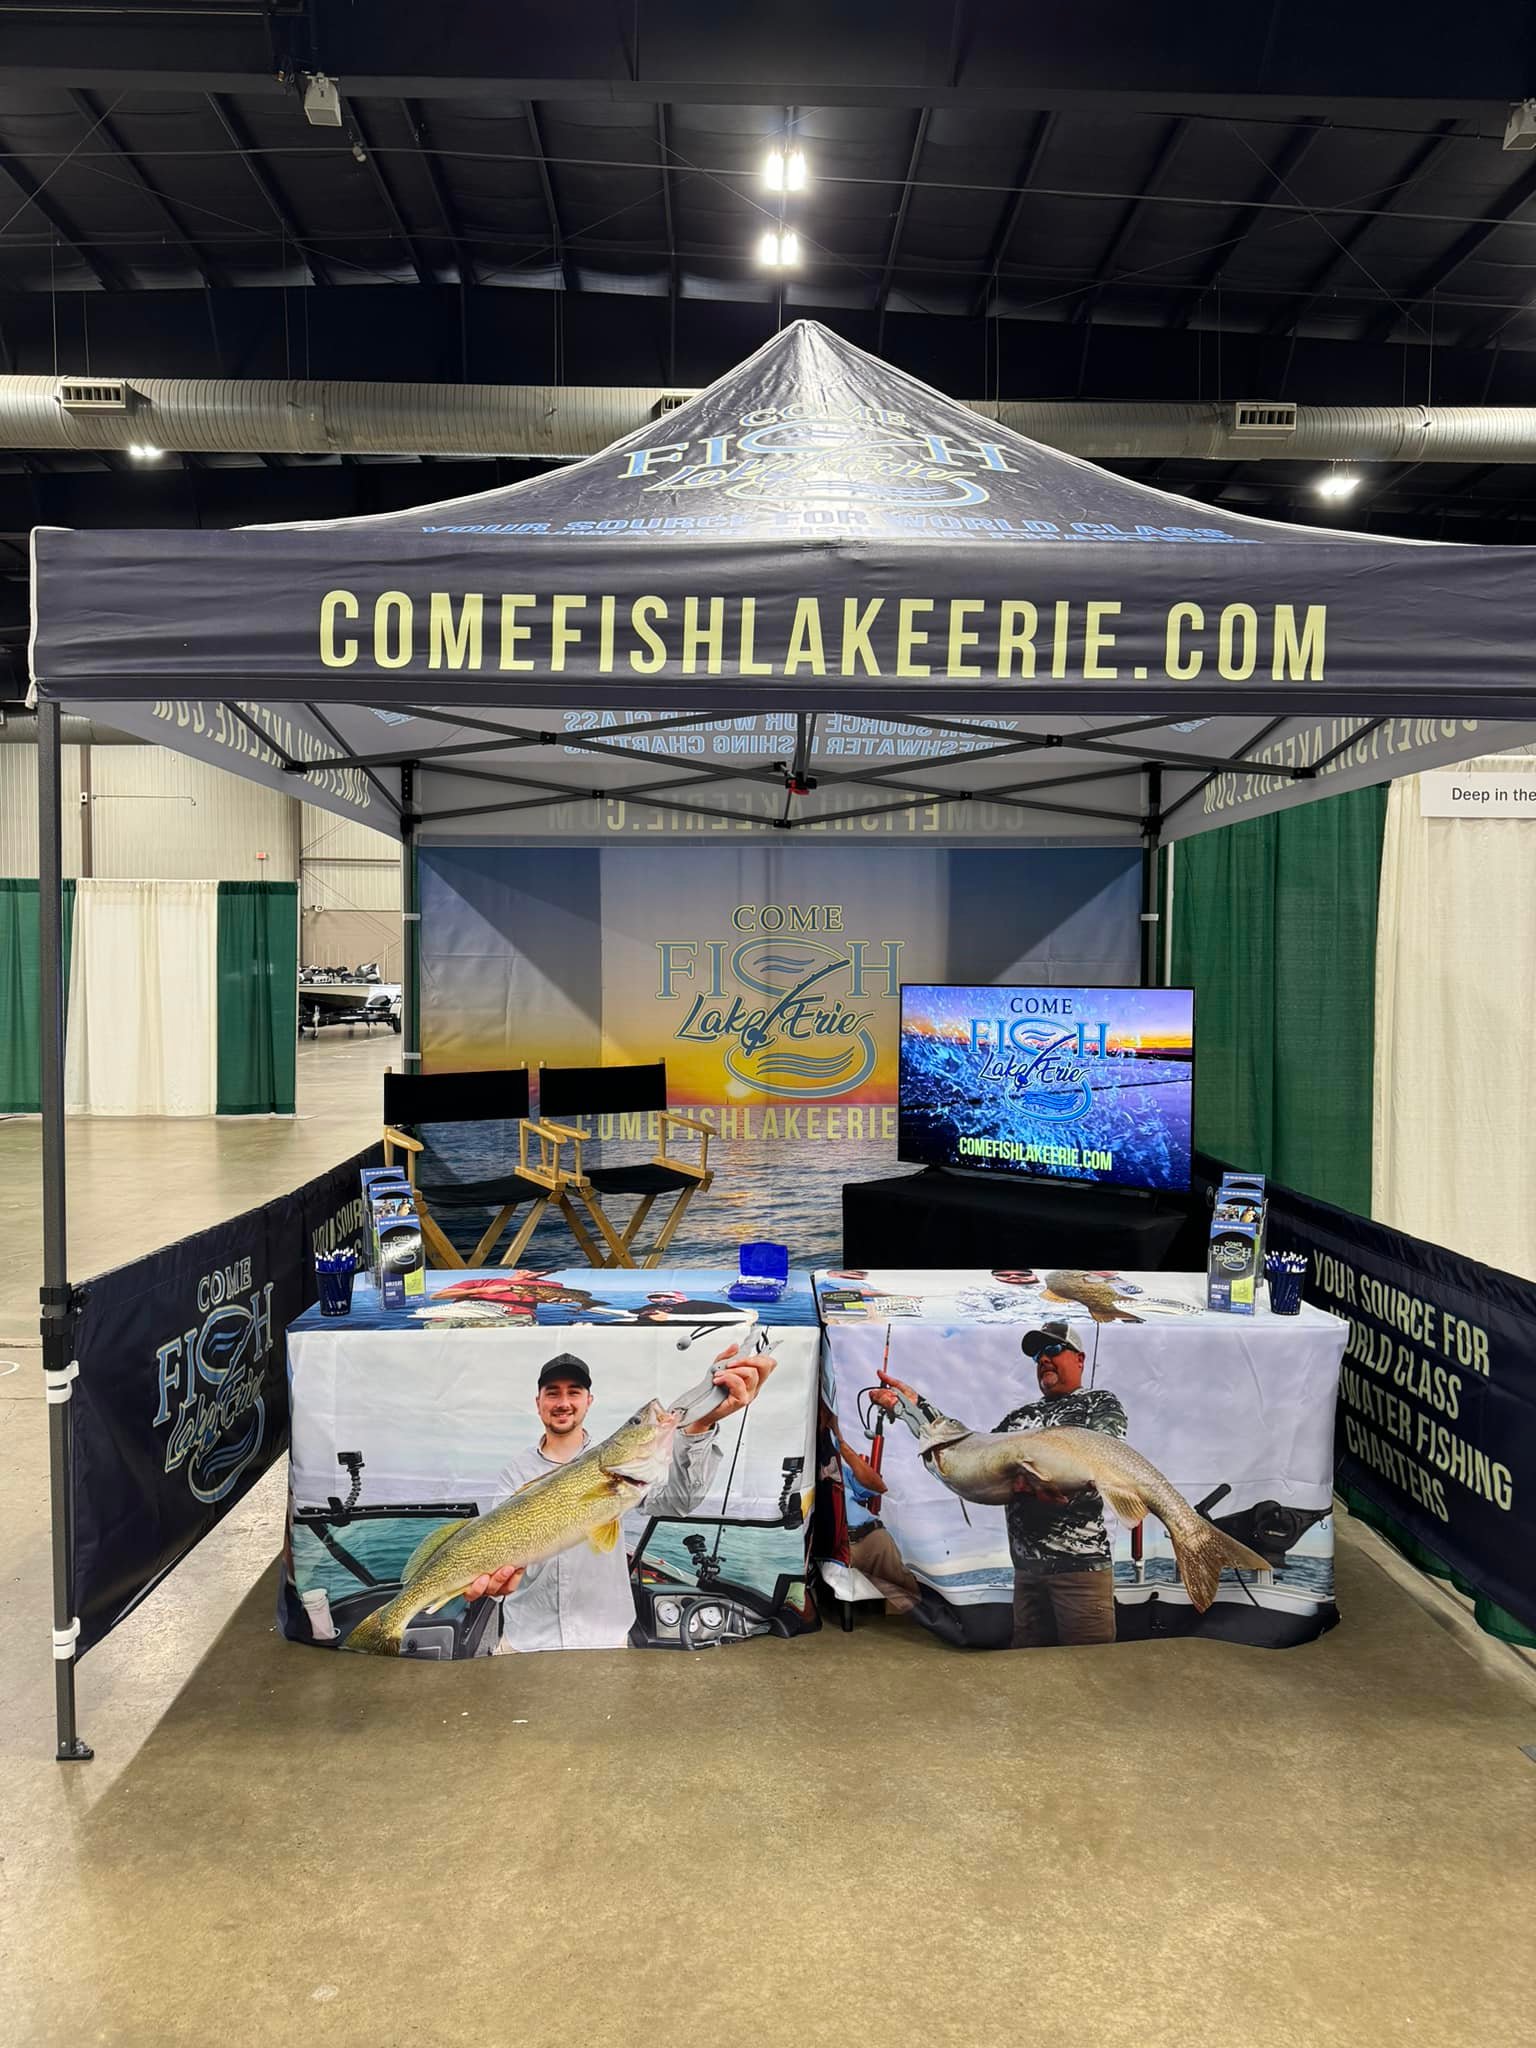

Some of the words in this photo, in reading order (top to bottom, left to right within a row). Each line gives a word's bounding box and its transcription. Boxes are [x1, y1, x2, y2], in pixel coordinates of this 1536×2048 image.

[739, 403, 909, 428] COME
[421, 521, 552, 535] YOUR
[564, 512, 753, 531] SOURCE
[773, 509, 868, 528] FOR
[890, 512, 1061, 535] WORLD
[1068, 521, 1236, 539] CLASS
[319, 589, 1327, 682] COMEFISHLAKEERIE.COM
[1452, 787, 1490, 804] Deep
[1495, 788, 1508, 801] in
[1513, 788, 1536, 801] the
[732, 904, 844, 932] COME
[674, 994, 775, 1054] Lake
[780, 995, 875, 1039] Erie
[1010, 997, 1074, 1015] COME
[977, 1052, 1033, 1090] Lake
[1036, 1056, 1090, 1084] Erie
[959, 1136, 1113, 1171] COMEFISHLAKEERIE.COM
[197, 1256, 253, 1312] COME
[1313, 1249, 1357, 1308] YOUR
[1360, 1274, 1437, 1349] SOURCE
[1443, 1311, 1490, 1377] FOR
[1330, 1305, 1393, 1375] ORLD
[1393, 1345, 1462, 1420] CLASS
[1339, 1364, 1412, 1446] WATER
[1417, 1412, 1513, 1511] FISHING
[1345, 1415, 1449, 1523] CHARTERS
